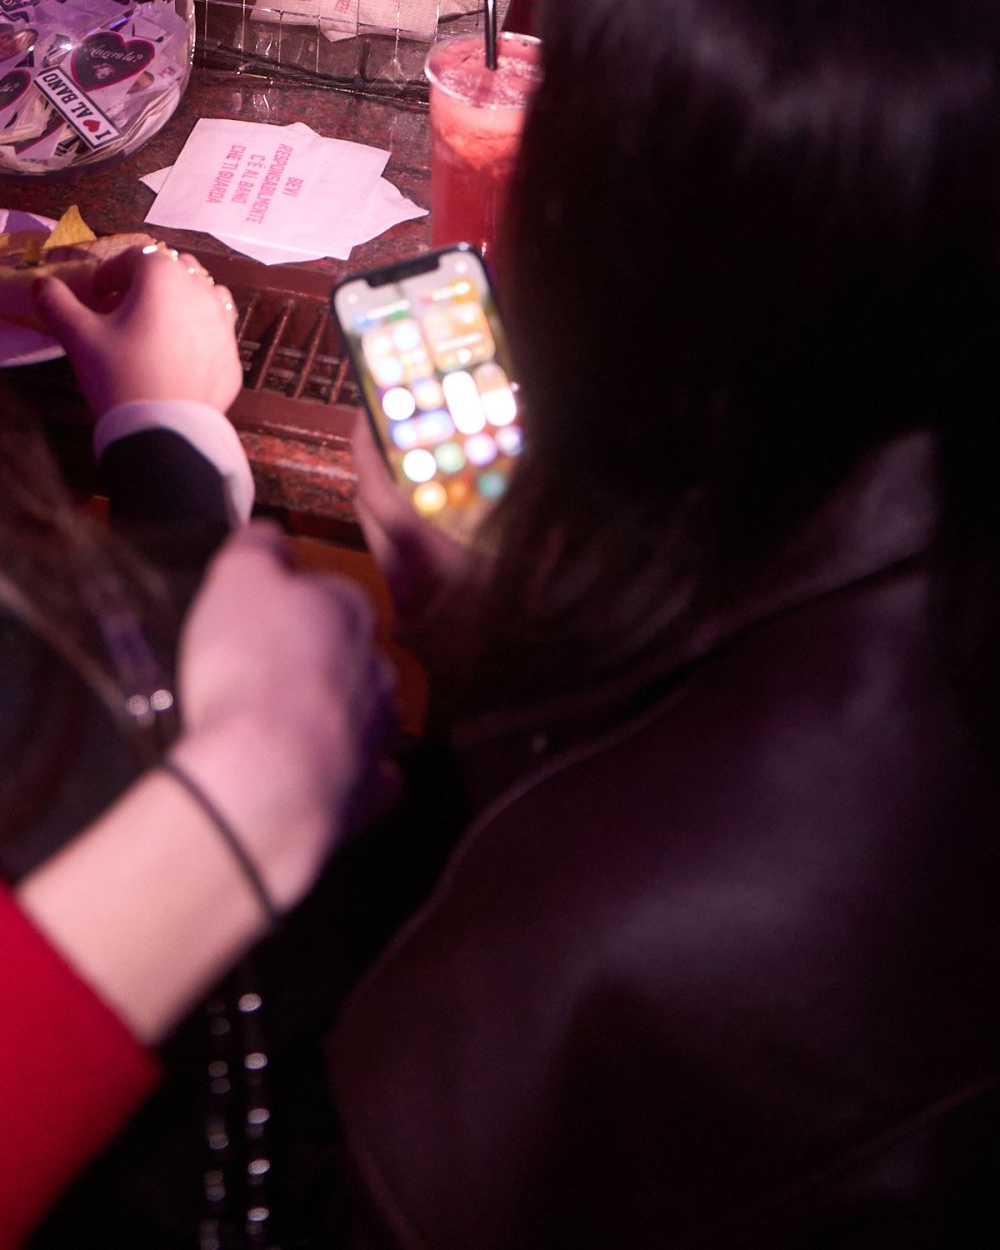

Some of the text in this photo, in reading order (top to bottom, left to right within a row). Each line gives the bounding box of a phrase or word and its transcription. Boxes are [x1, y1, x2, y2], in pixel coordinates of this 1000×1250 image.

[42, 72, 113, 140] I AL BANO
[205, 145, 246, 204] CHE TI GUARDA
[231, 181, 254, 204] BANO
[242, 169, 259, 179] AL
[246, 143, 293, 225] RESPONSABILMENTE
[282, 177, 304, 197] BEVI
